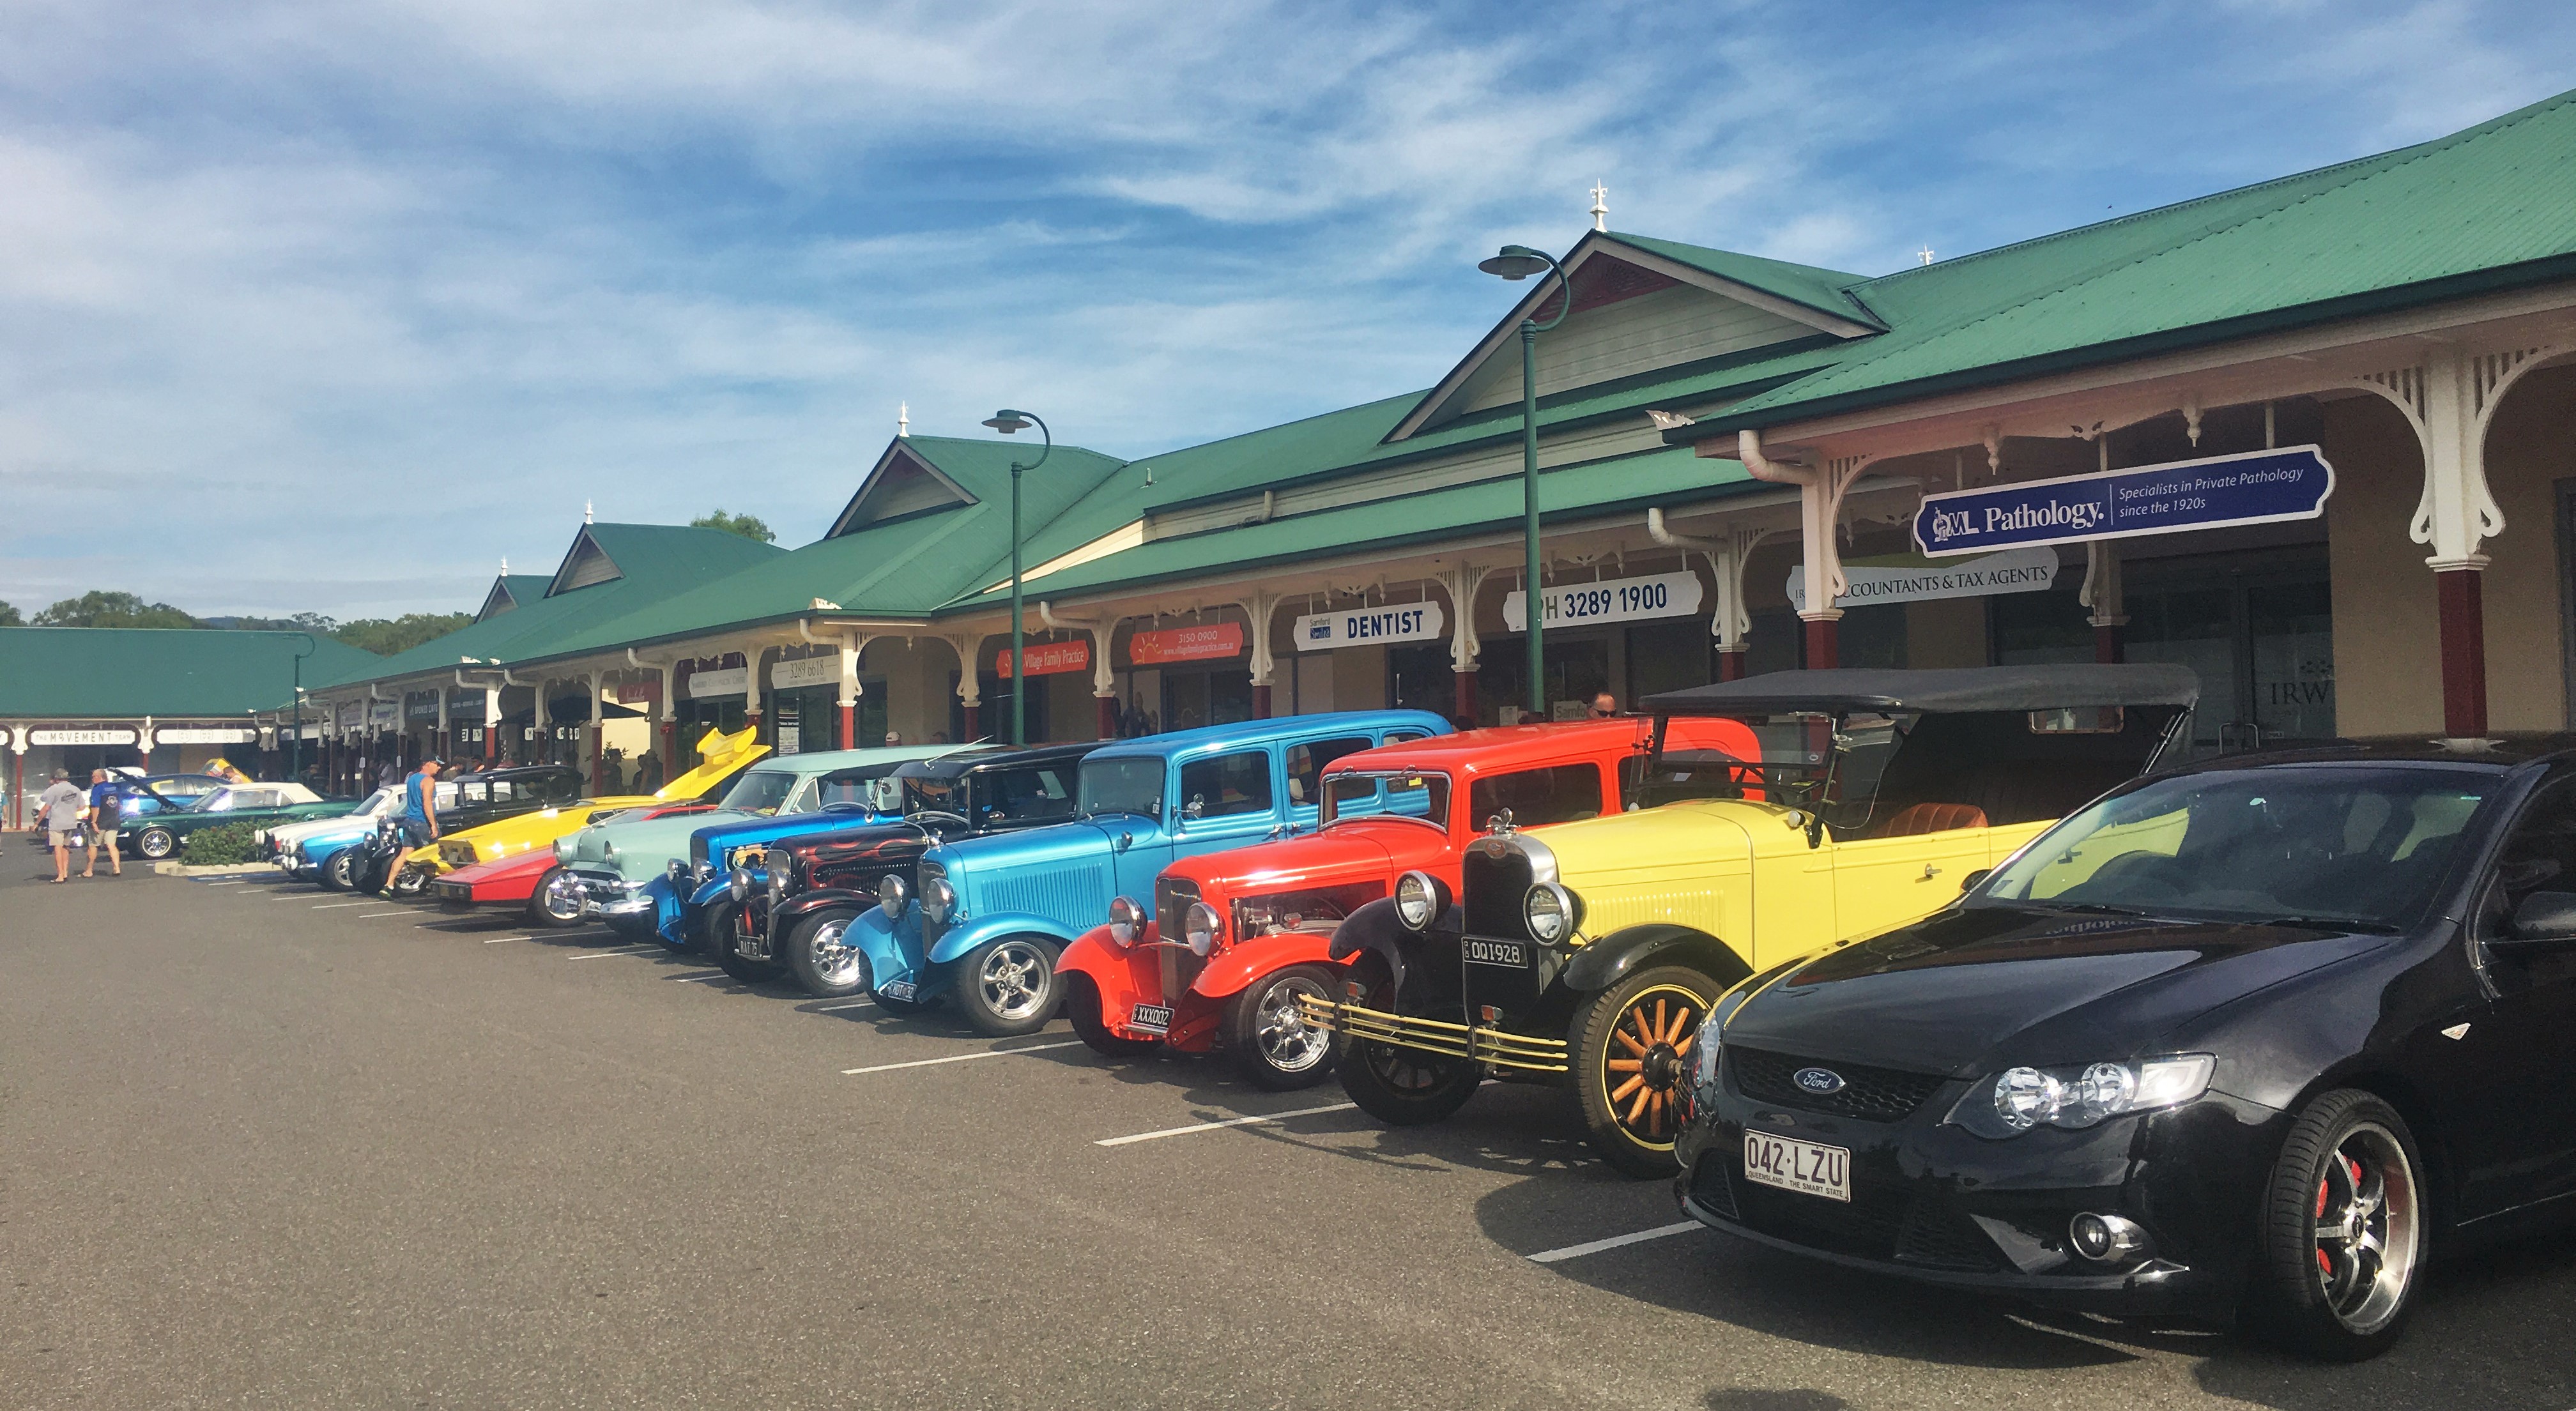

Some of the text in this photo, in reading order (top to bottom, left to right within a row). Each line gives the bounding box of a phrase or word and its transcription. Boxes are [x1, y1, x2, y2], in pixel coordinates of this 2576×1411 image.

[2119, 468, 2304, 501] Specialists in Private Pathology
[1984, 500, 2104, 533] Pathology.
[2120, 497, 2206, 517] since the 1920s
[1942, 575, 1955, 589] &
[1957, 572, 1984, 587] TAX
[1988, 566, 2048, 585] AGENTS
[1565, 589, 1611, 618] 3289
[1619, 583, 1667, 612] 1900
[1347, 610, 1423, 639] DENTIST
[1179, 630, 1217, 643] 3150 0900
[790, 659, 824, 678] 3289 6618
[1024, 648, 1084, 669] Village Family Practice
[1556, 705, 1586, 718] Samfo
[50, 733, 111, 742] MOVEMENT
[1137, 1006, 1169, 1025] XXX002
[1804, 1071, 1831, 1089] Ford
[1748, 1170, 1843, 1197] QUEENSLAND THE SMART STATE
